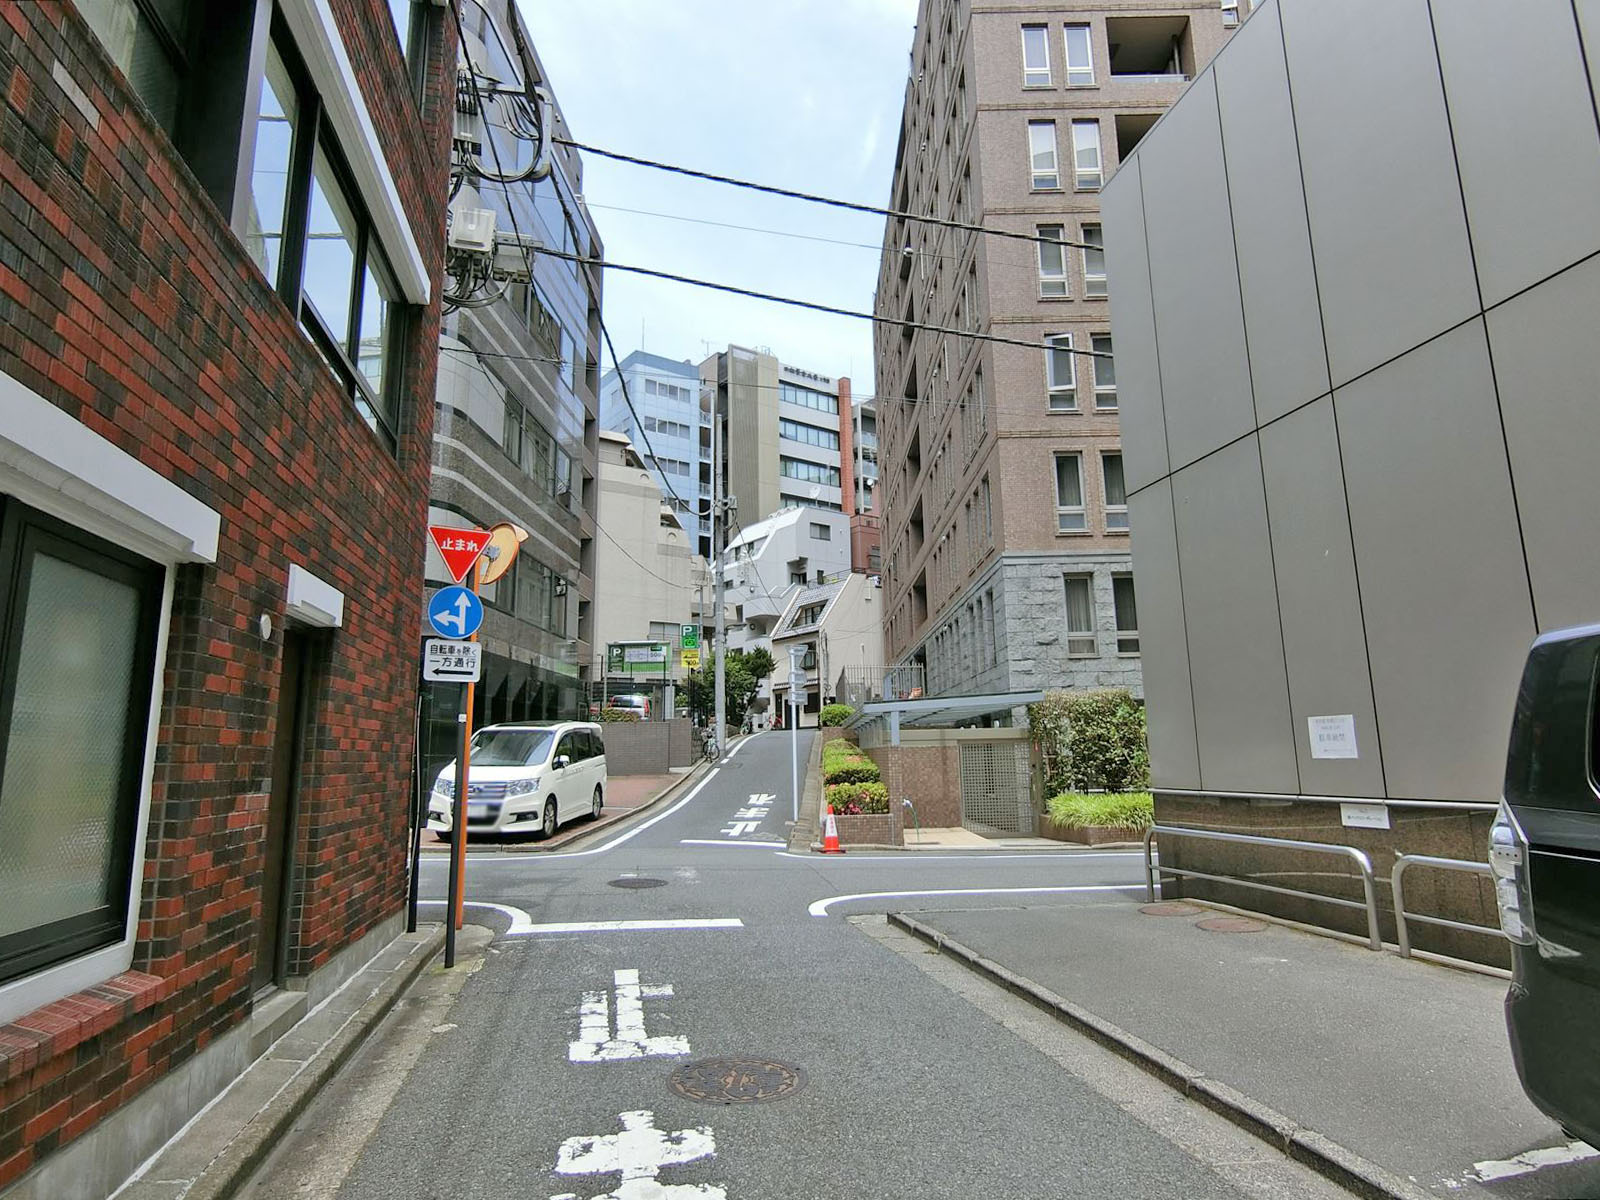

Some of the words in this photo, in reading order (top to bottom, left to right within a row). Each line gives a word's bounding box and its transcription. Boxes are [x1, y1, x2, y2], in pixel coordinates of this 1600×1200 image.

[441, 537, 480, 552] 止まれ
[683, 626, 692, 636] P
[430, 644, 476, 656] 自転車を除く
[613, 648, 621, 657] P
[430, 657, 476, 669] 一方通行
